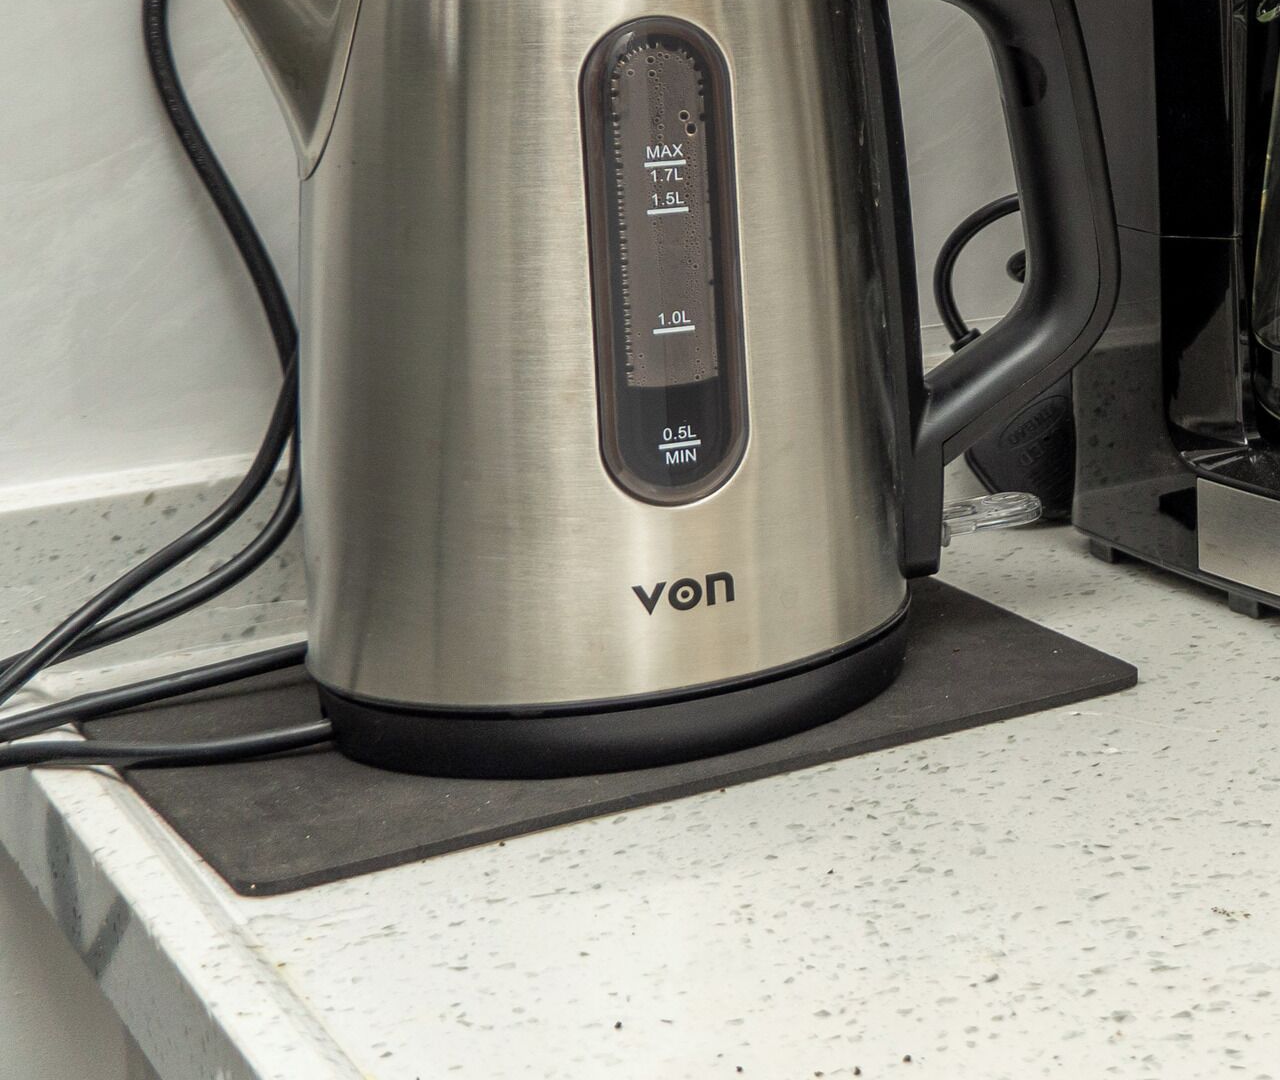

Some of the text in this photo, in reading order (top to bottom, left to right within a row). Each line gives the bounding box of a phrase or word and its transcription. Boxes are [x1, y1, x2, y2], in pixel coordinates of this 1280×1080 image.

[646, 143, 684, 160] MAX
[649, 167, 684, 183] 1.7L
[651, 191, 685, 208] 1.5L
[658, 310, 692, 326] 1.0L
[662, 425, 697, 442] 0.5L
[664, 448, 698, 465] MIN
